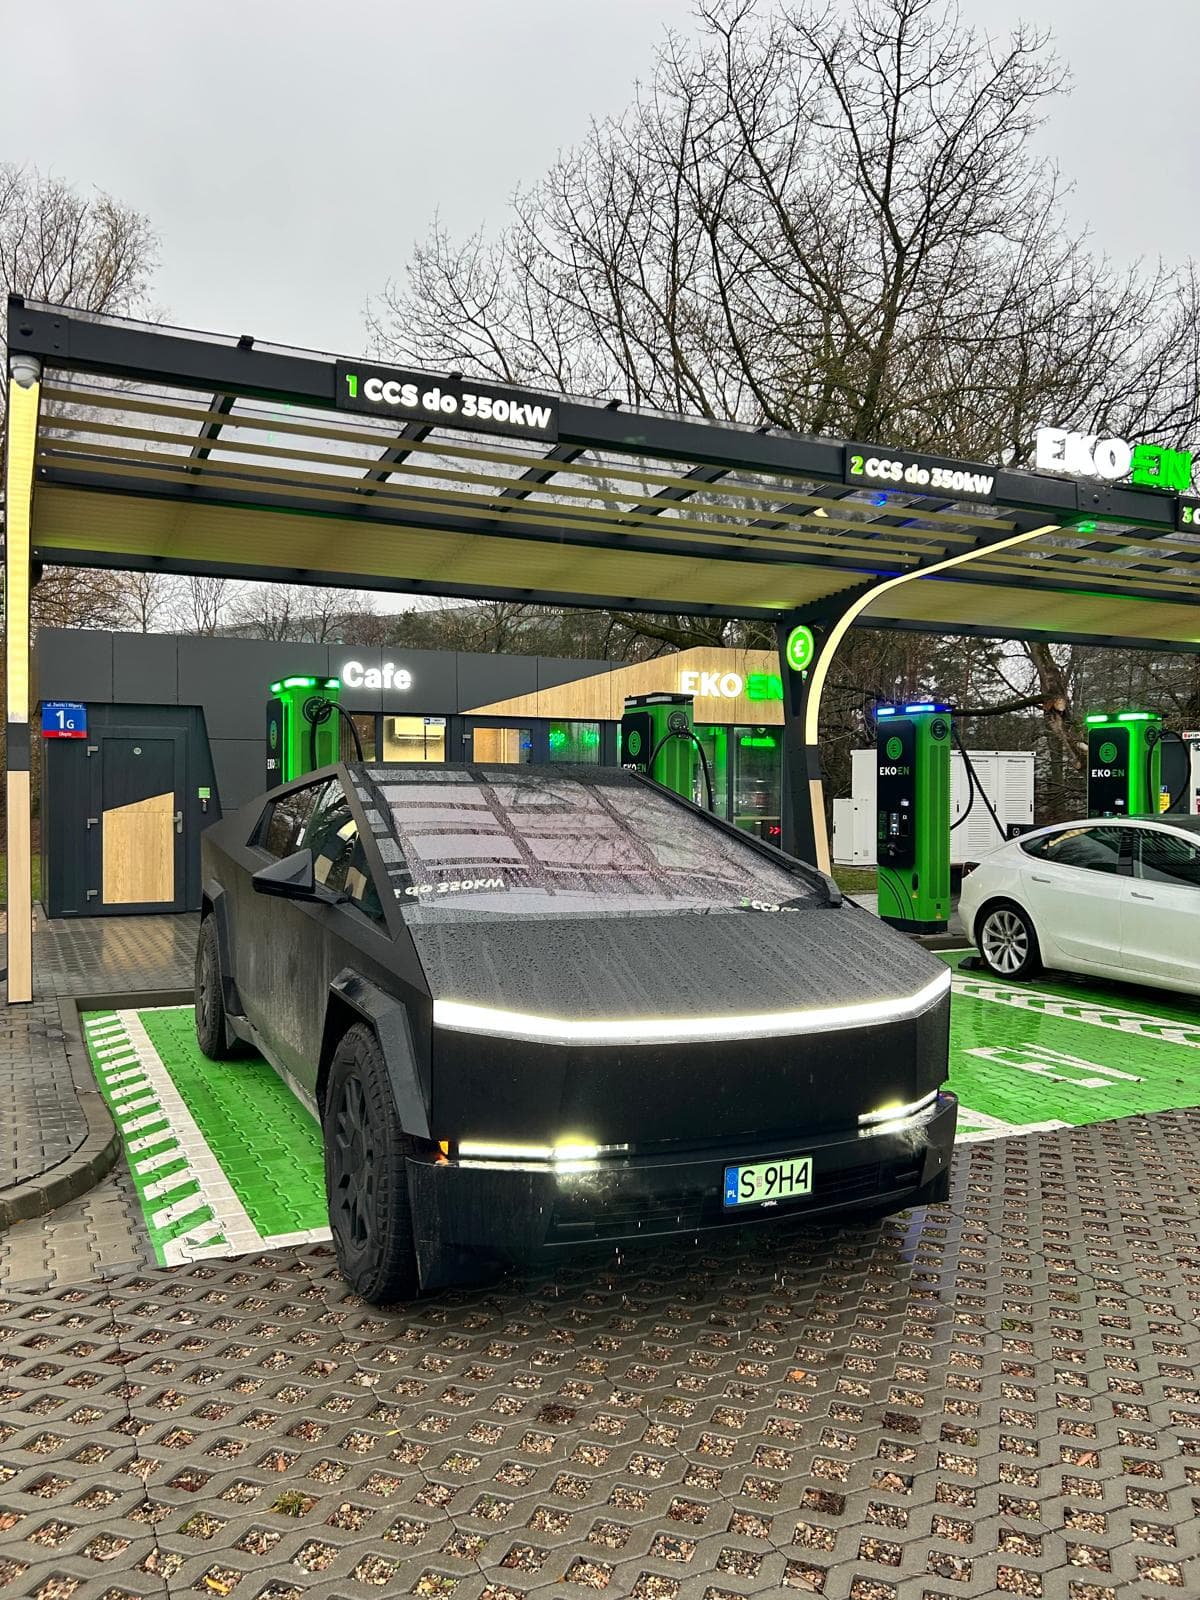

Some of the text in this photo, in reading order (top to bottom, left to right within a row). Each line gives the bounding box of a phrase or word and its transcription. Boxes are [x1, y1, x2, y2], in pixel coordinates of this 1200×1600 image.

[345, 374, 552, 429] 1 CCS do 350kW
[850, 455, 994, 496] 2 CCS do 350kW
[342, 661, 411, 690] Cafe
[879, 766, 910, 776] EKOEN
[1091, 769, 1125, 778] EKOEN
[740, 1169, 755, 1198] S
[764, 1161, 809, 1195] 9H4
